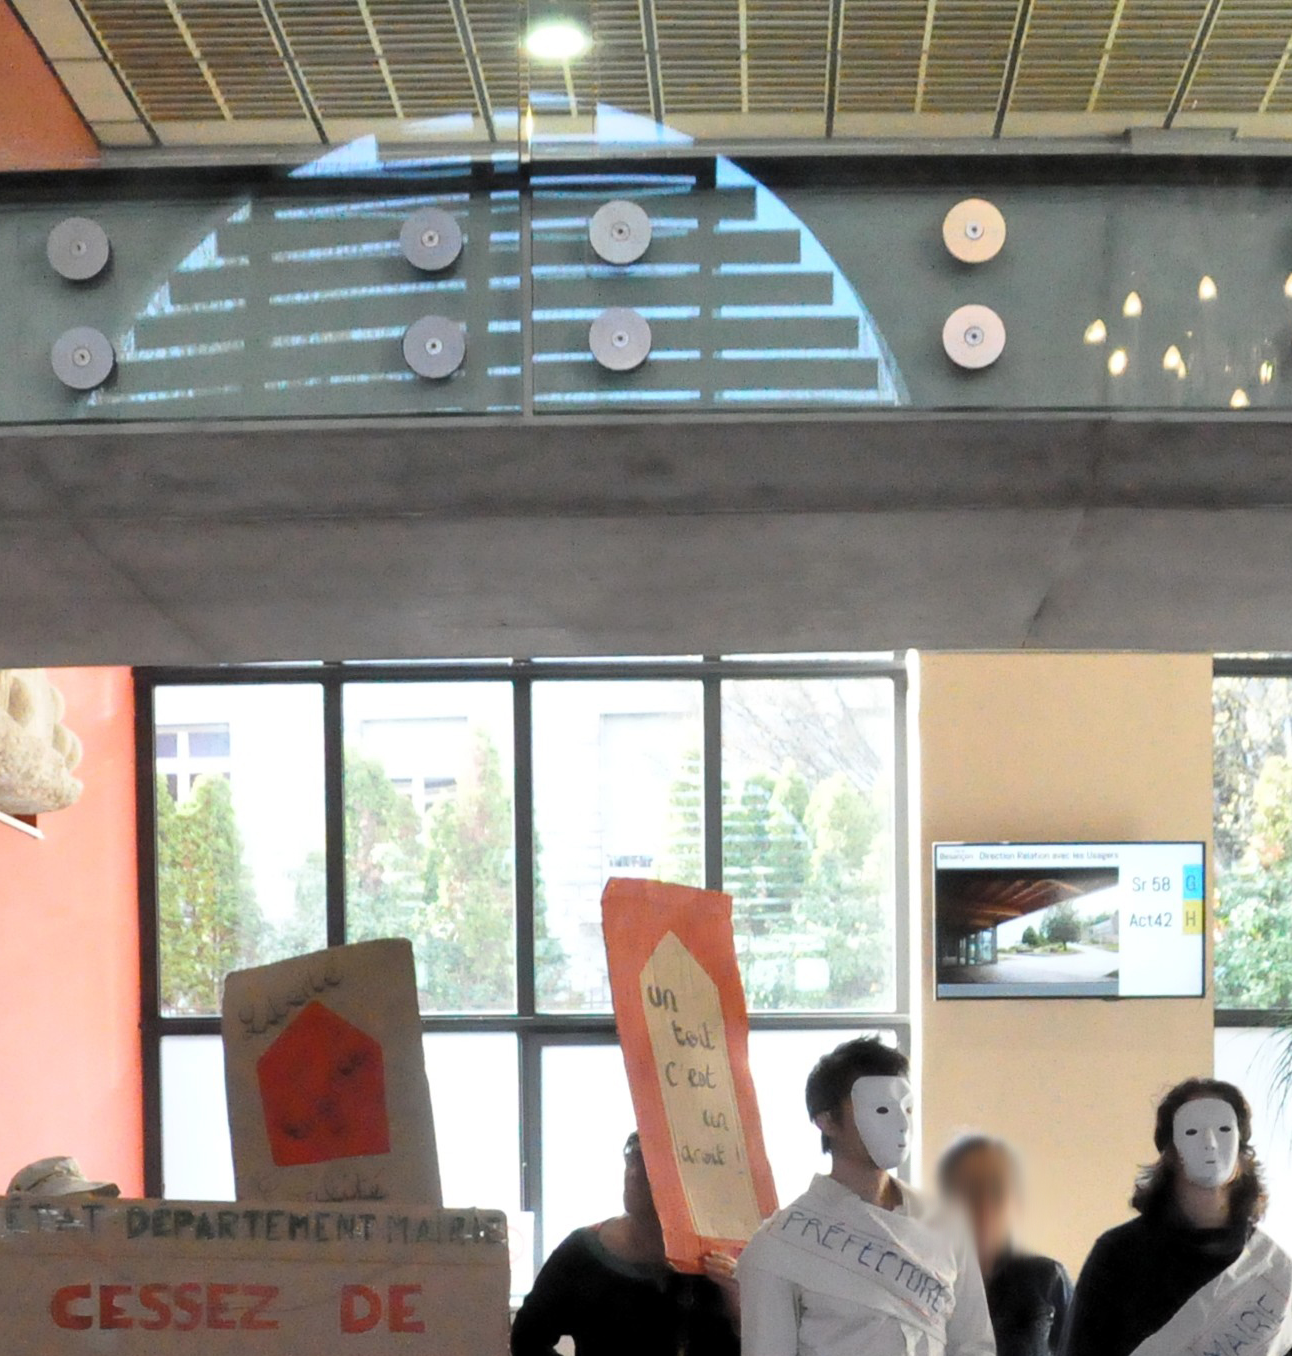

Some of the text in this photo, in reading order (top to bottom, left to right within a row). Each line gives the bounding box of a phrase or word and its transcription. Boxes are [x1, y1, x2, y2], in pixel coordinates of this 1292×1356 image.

[979, 851, 1015, 861] Direction
[1017, 851, 1049, 861] Relation
[1086, 851, 1119, 862] Usagers
[1132, 876, 1171, 892] Sr 58
[1185, 874, 1196, 891] G
[1185, 911, 1196, 927] H
[51, 1281, 426, 1334] CESSEZ DE
